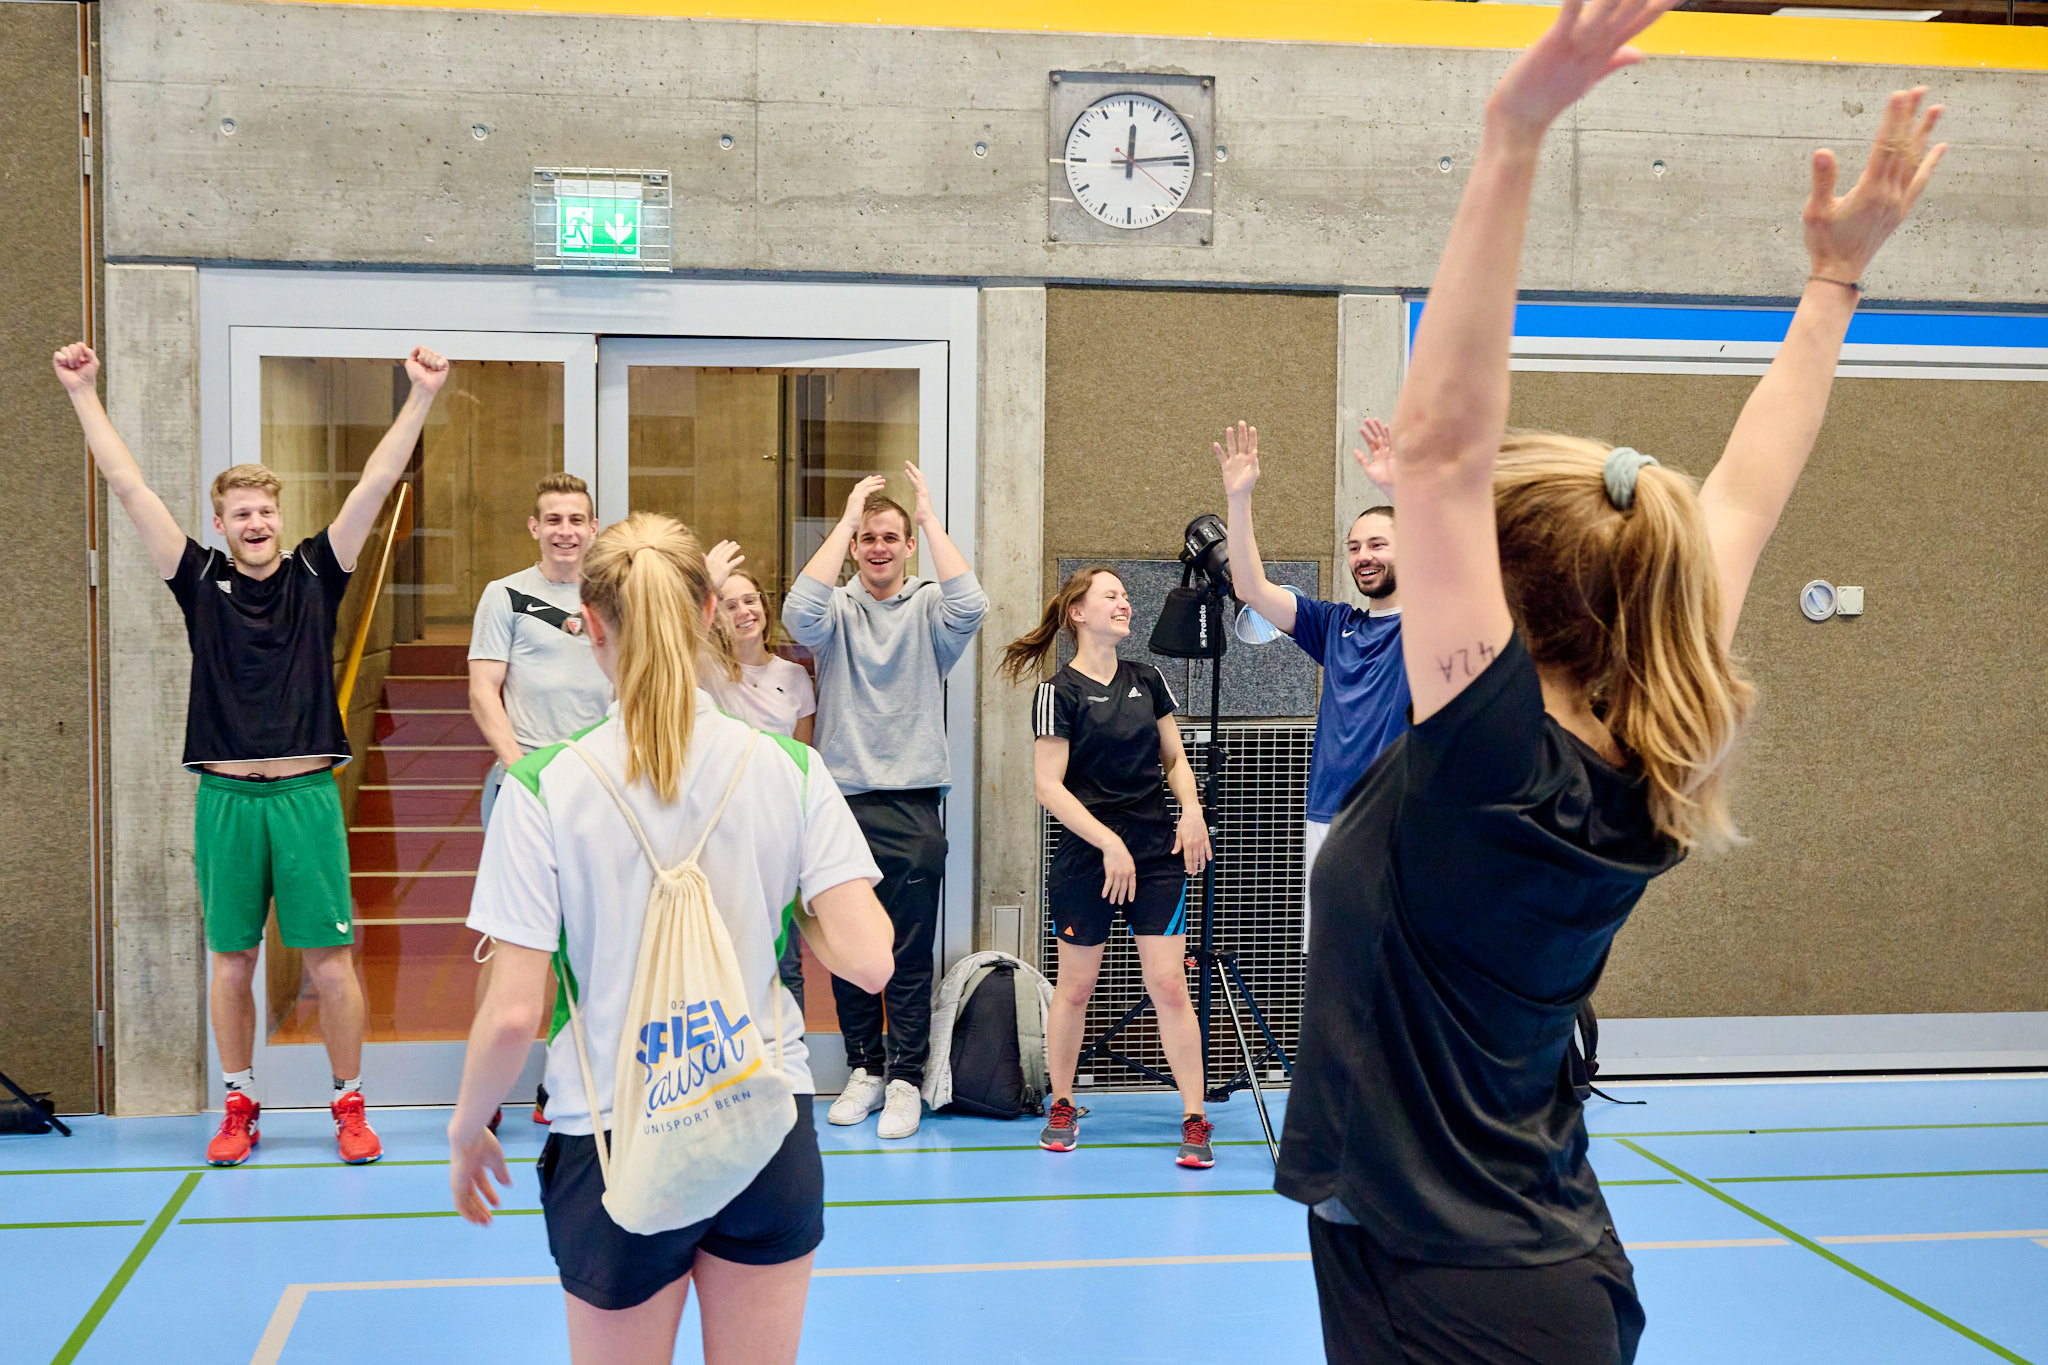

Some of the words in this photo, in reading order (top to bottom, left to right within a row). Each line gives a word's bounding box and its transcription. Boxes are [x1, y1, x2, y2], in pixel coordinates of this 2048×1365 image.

[1199, 604, 1207, 638] Profoto
[643, 1108, 710, 1135] UNISPORT
[715, 1090, 751, 1110] BERN
